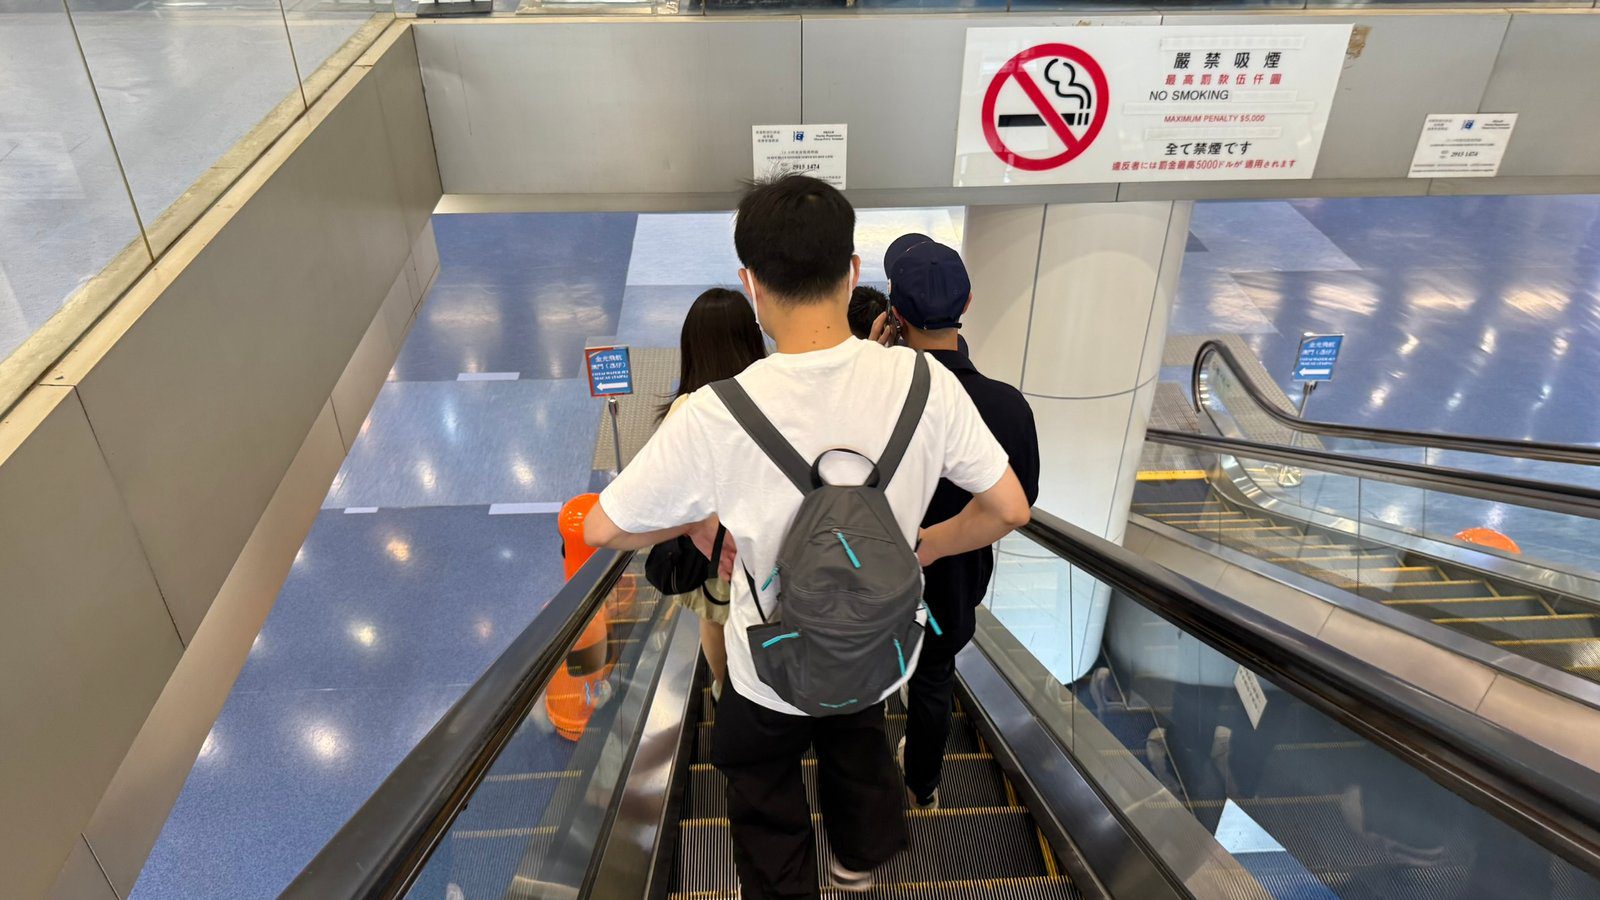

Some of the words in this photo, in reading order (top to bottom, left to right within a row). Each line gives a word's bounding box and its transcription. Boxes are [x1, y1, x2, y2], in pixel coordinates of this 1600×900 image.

[1174, 52, 1282, 69] 嚴禁吸煙
[1149, 90, 1168, 101] NO
[1171, 89, 1229, 101] SMOKING
[1164, 115, 1202, 123] MAXIMUM
[1203, 114, 1239, 123] PENALTY
[1240, 114, 1265, 122] $5,000
[1165, 142, 1252, 156] 全て禁煙です
